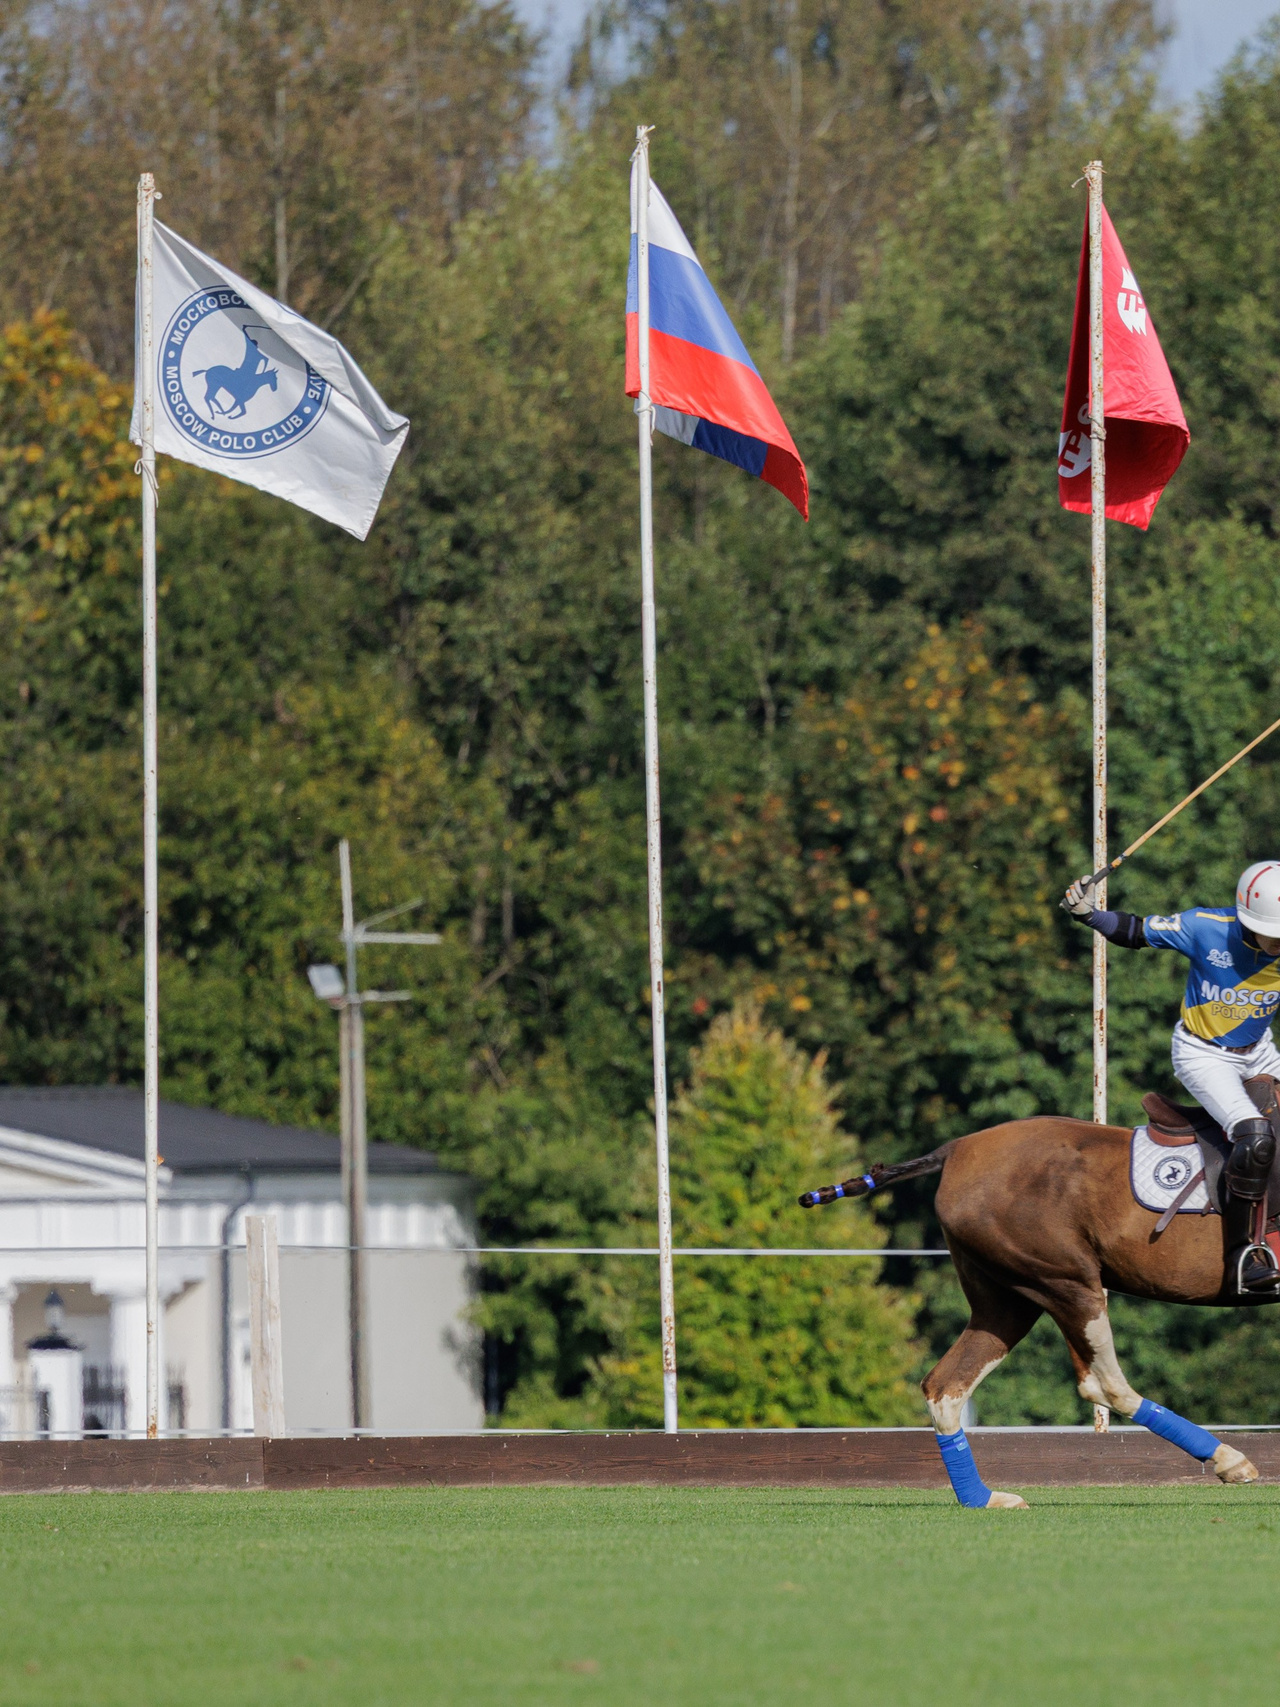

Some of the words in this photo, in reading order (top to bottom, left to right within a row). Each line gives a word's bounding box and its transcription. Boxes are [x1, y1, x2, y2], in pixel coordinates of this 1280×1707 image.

[169, 293, 247, 346] МОСКОВС
[166, 366, 208, 437] MOSCOW
[208, 431, 256, 450] POLO
[261, 414, 304, 445] CLUB
[1212, 1004, 1249, 1020] POLO
